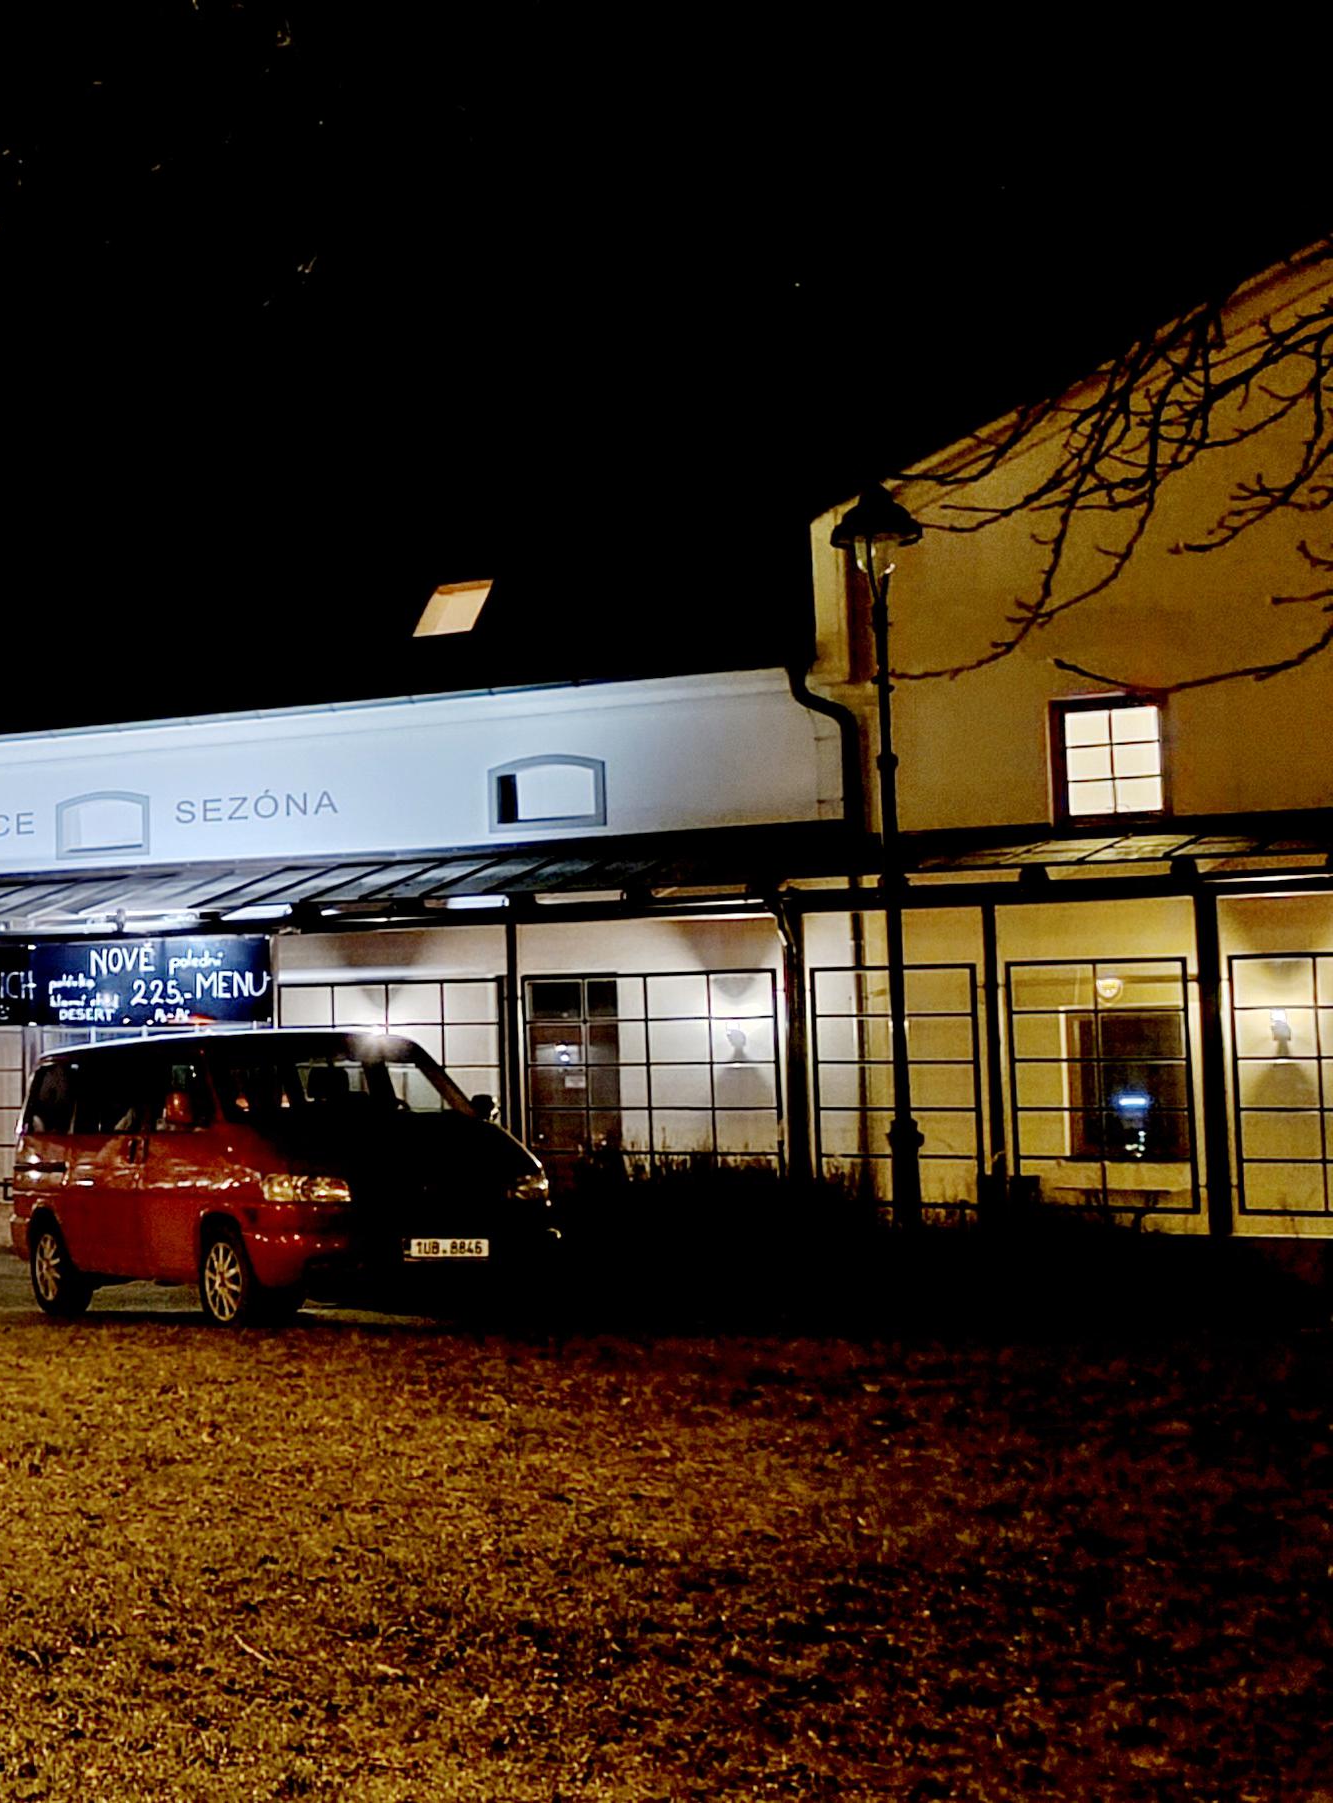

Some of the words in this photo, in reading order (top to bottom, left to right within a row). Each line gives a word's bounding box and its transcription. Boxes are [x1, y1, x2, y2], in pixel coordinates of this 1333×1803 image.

[175, 789, 338, 824] SEZÓNA
[90, 942, 155, 976] NOVÉ
[196, 971, 269, 999] MENU
[59, 1008, 116, 1021] DESERT
